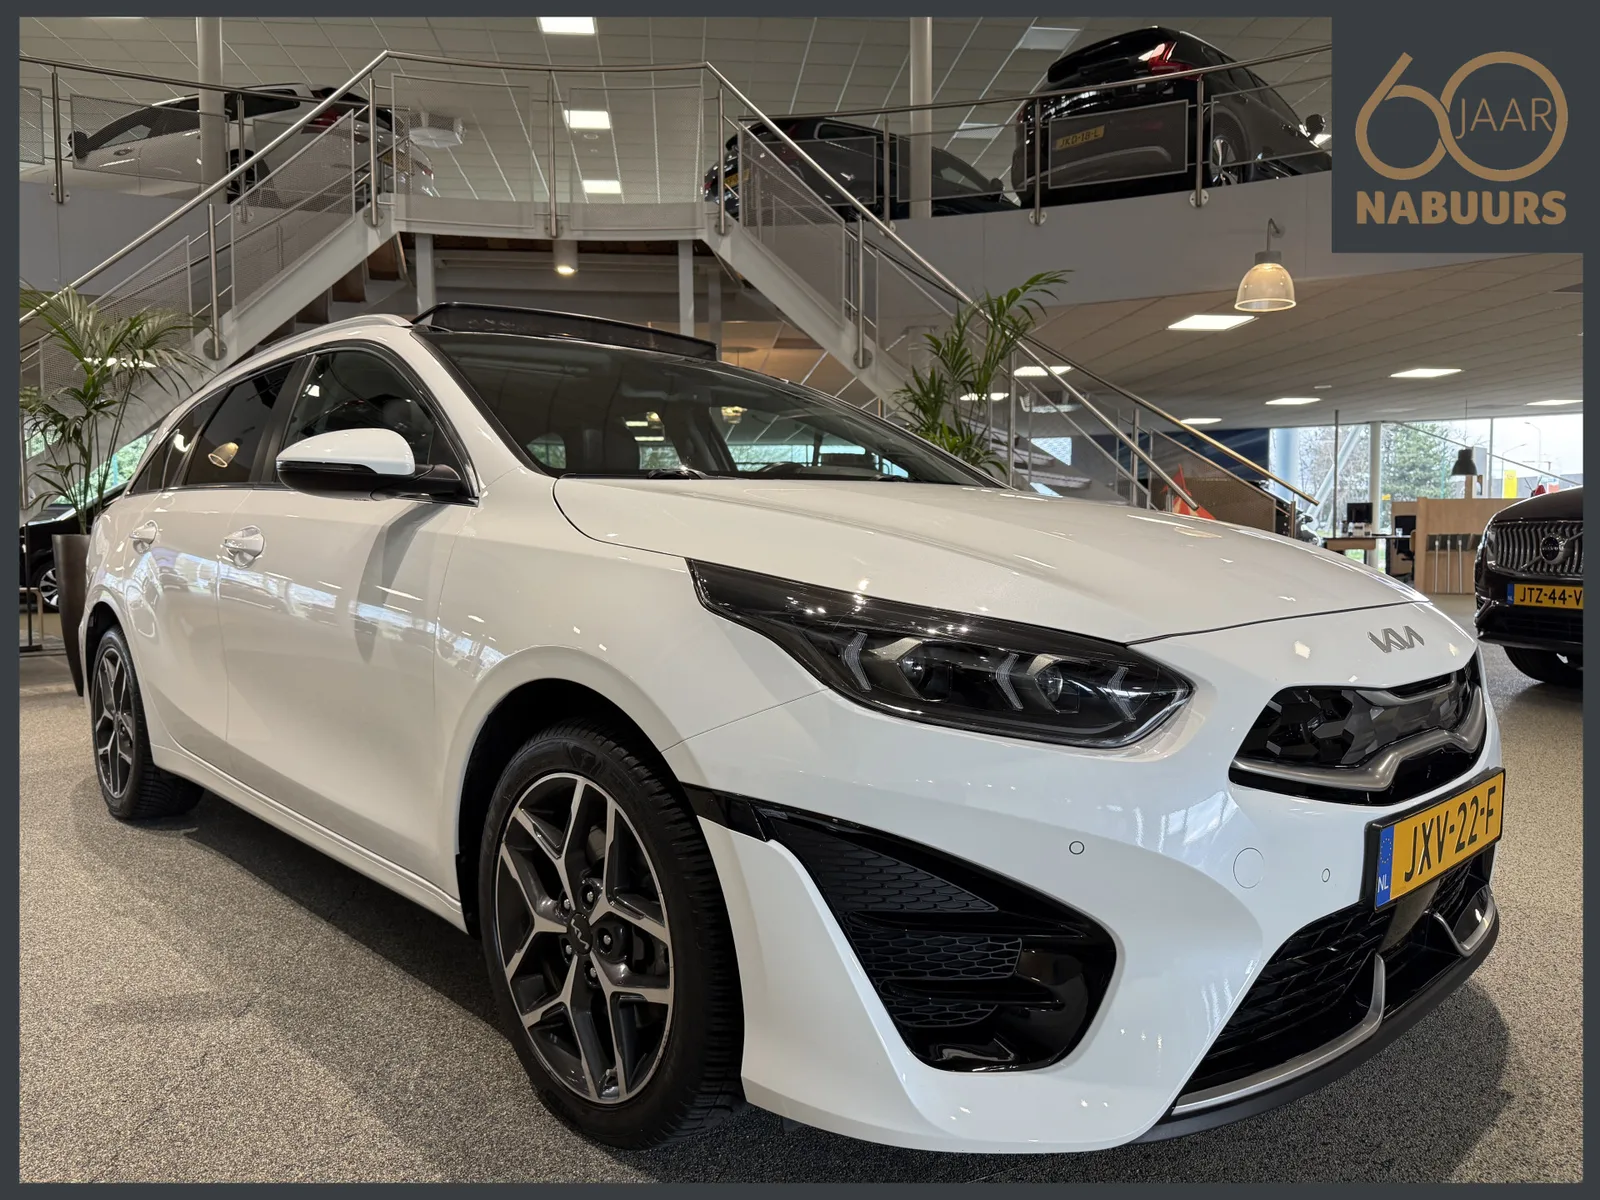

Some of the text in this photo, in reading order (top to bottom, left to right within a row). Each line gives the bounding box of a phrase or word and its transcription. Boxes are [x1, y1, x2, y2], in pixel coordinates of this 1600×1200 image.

[1519, 587, 1582, 606] JTZ-44-V
[1404, 785, 1496, 882] JXV-22-F
[1377, 874, 1389, 893] NL
